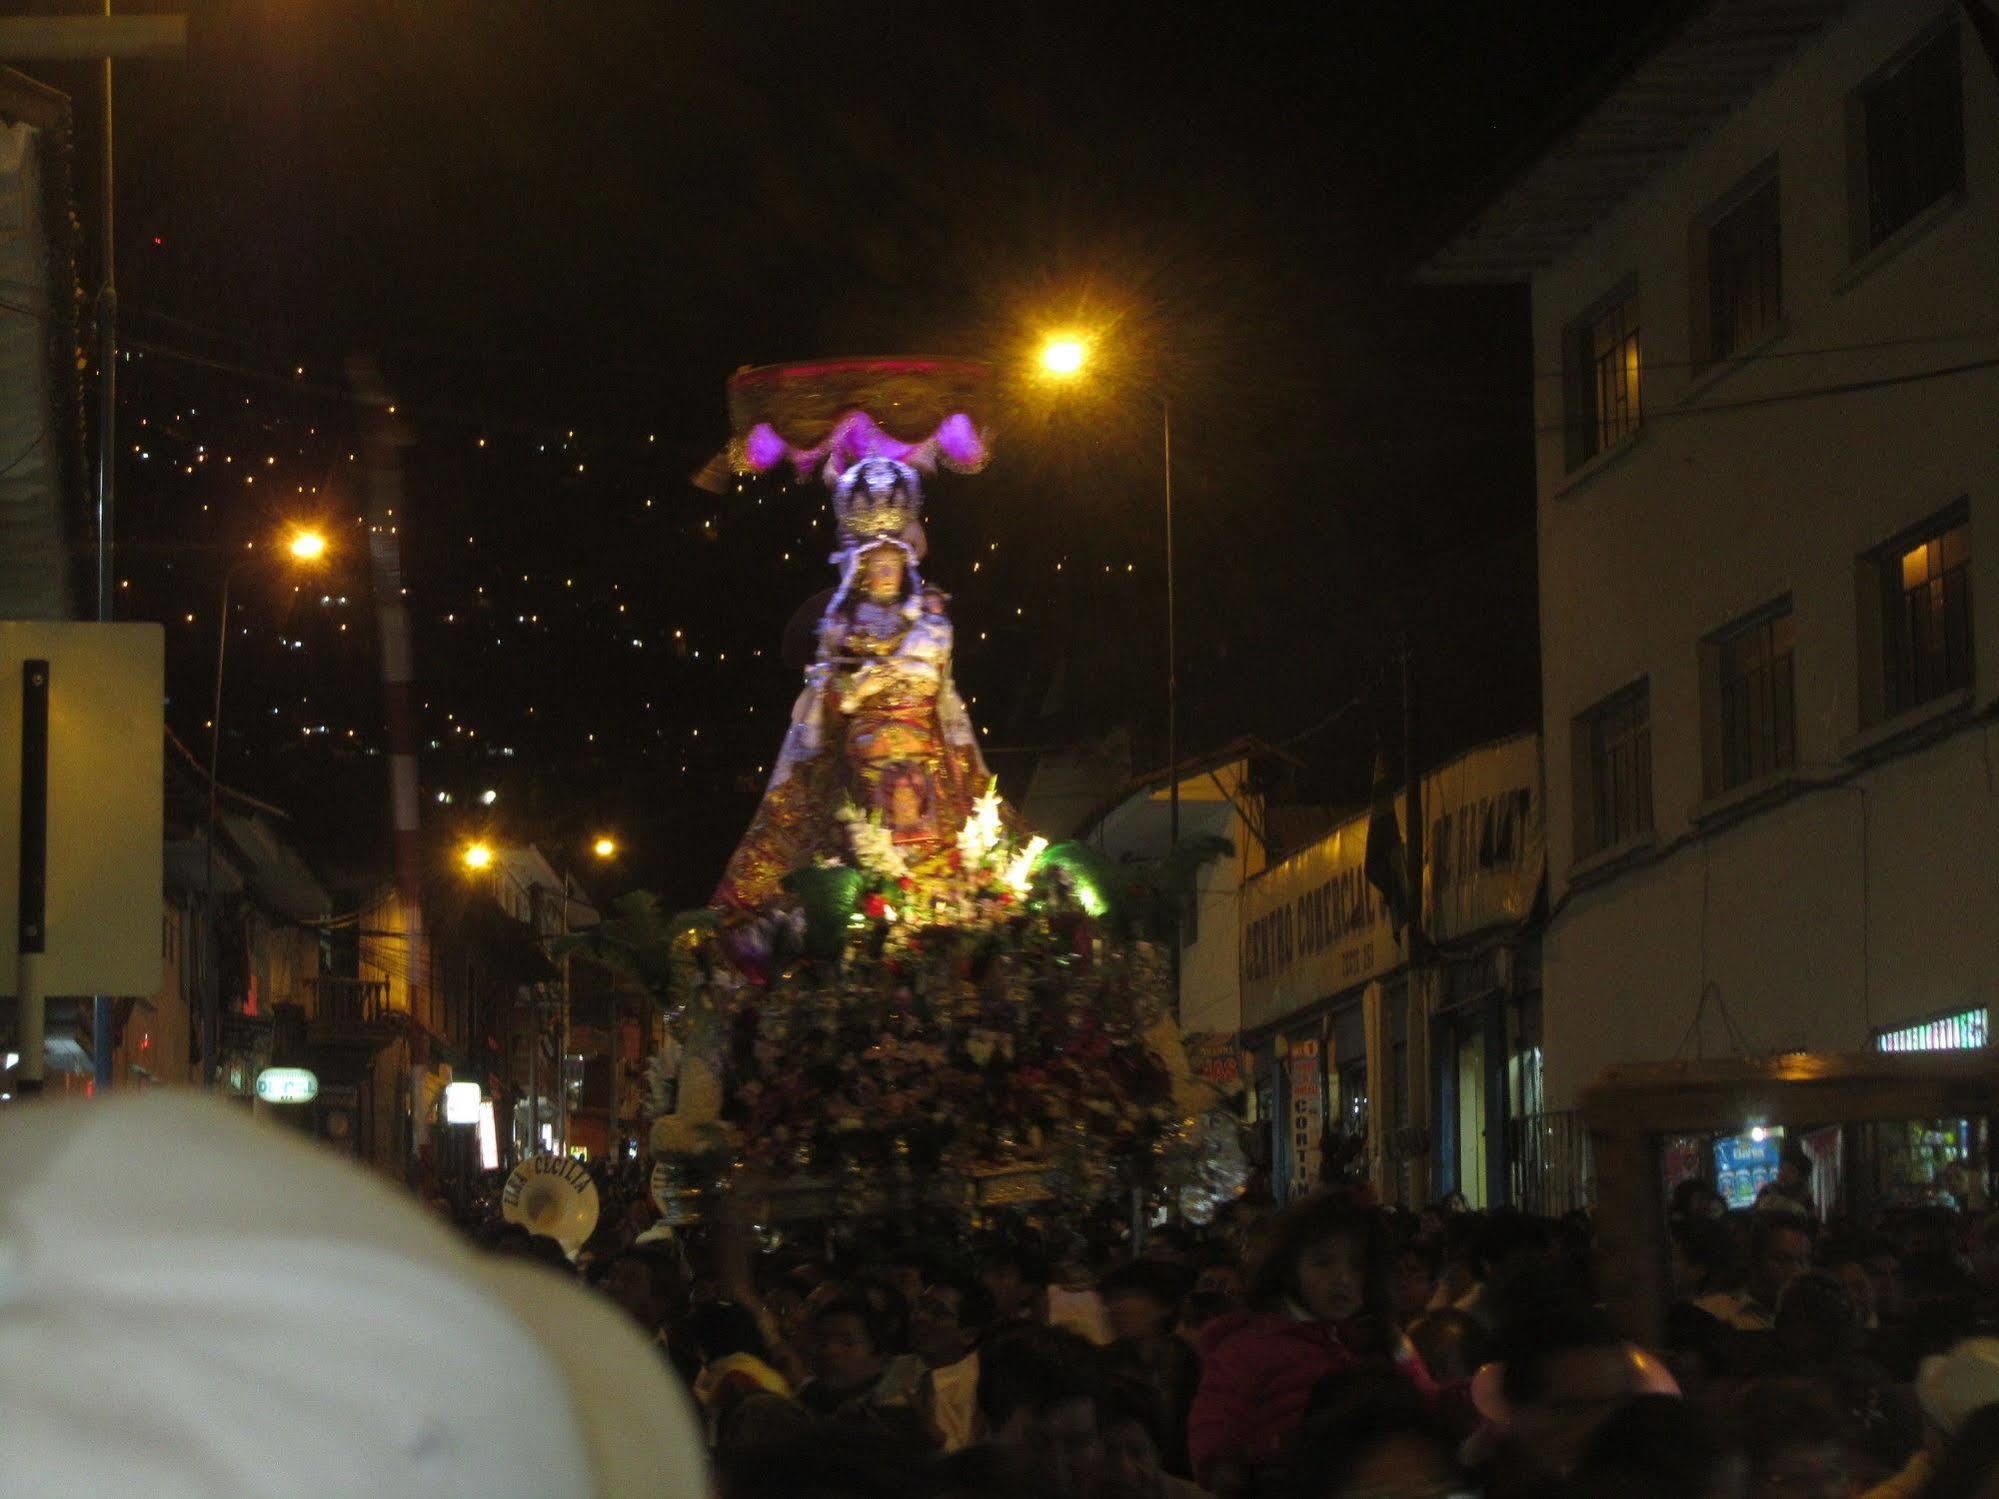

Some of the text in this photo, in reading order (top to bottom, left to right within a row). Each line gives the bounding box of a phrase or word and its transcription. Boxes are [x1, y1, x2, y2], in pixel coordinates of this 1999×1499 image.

[1245, 863, 1376, 982] CENTRO COMERCIAL
[535, 1156, 592, 1193] CECILIA
